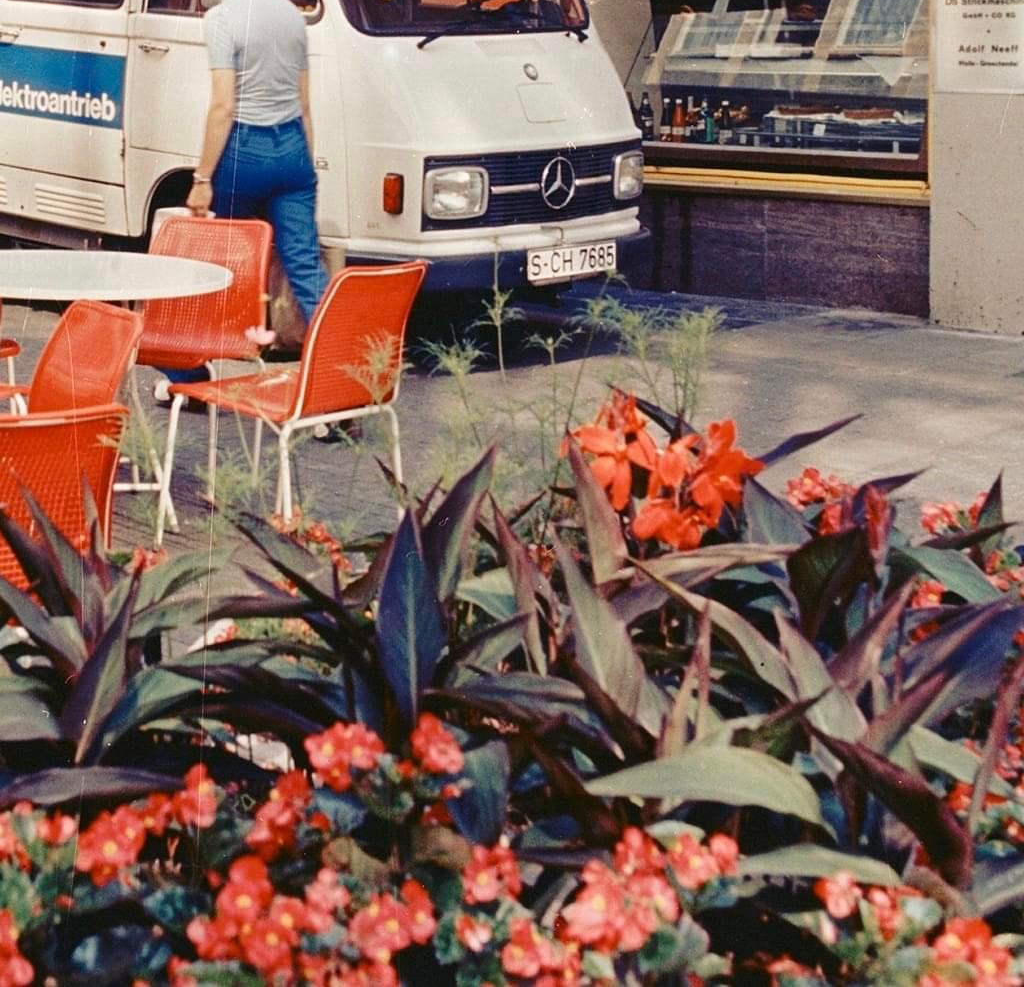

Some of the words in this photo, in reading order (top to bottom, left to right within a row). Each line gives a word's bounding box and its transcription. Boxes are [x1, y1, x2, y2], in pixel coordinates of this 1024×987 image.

[958, 44, 985, 53] Adolf
[531, 251, 573, 276] S-CH
[579, 245, 614, 270] 7685
